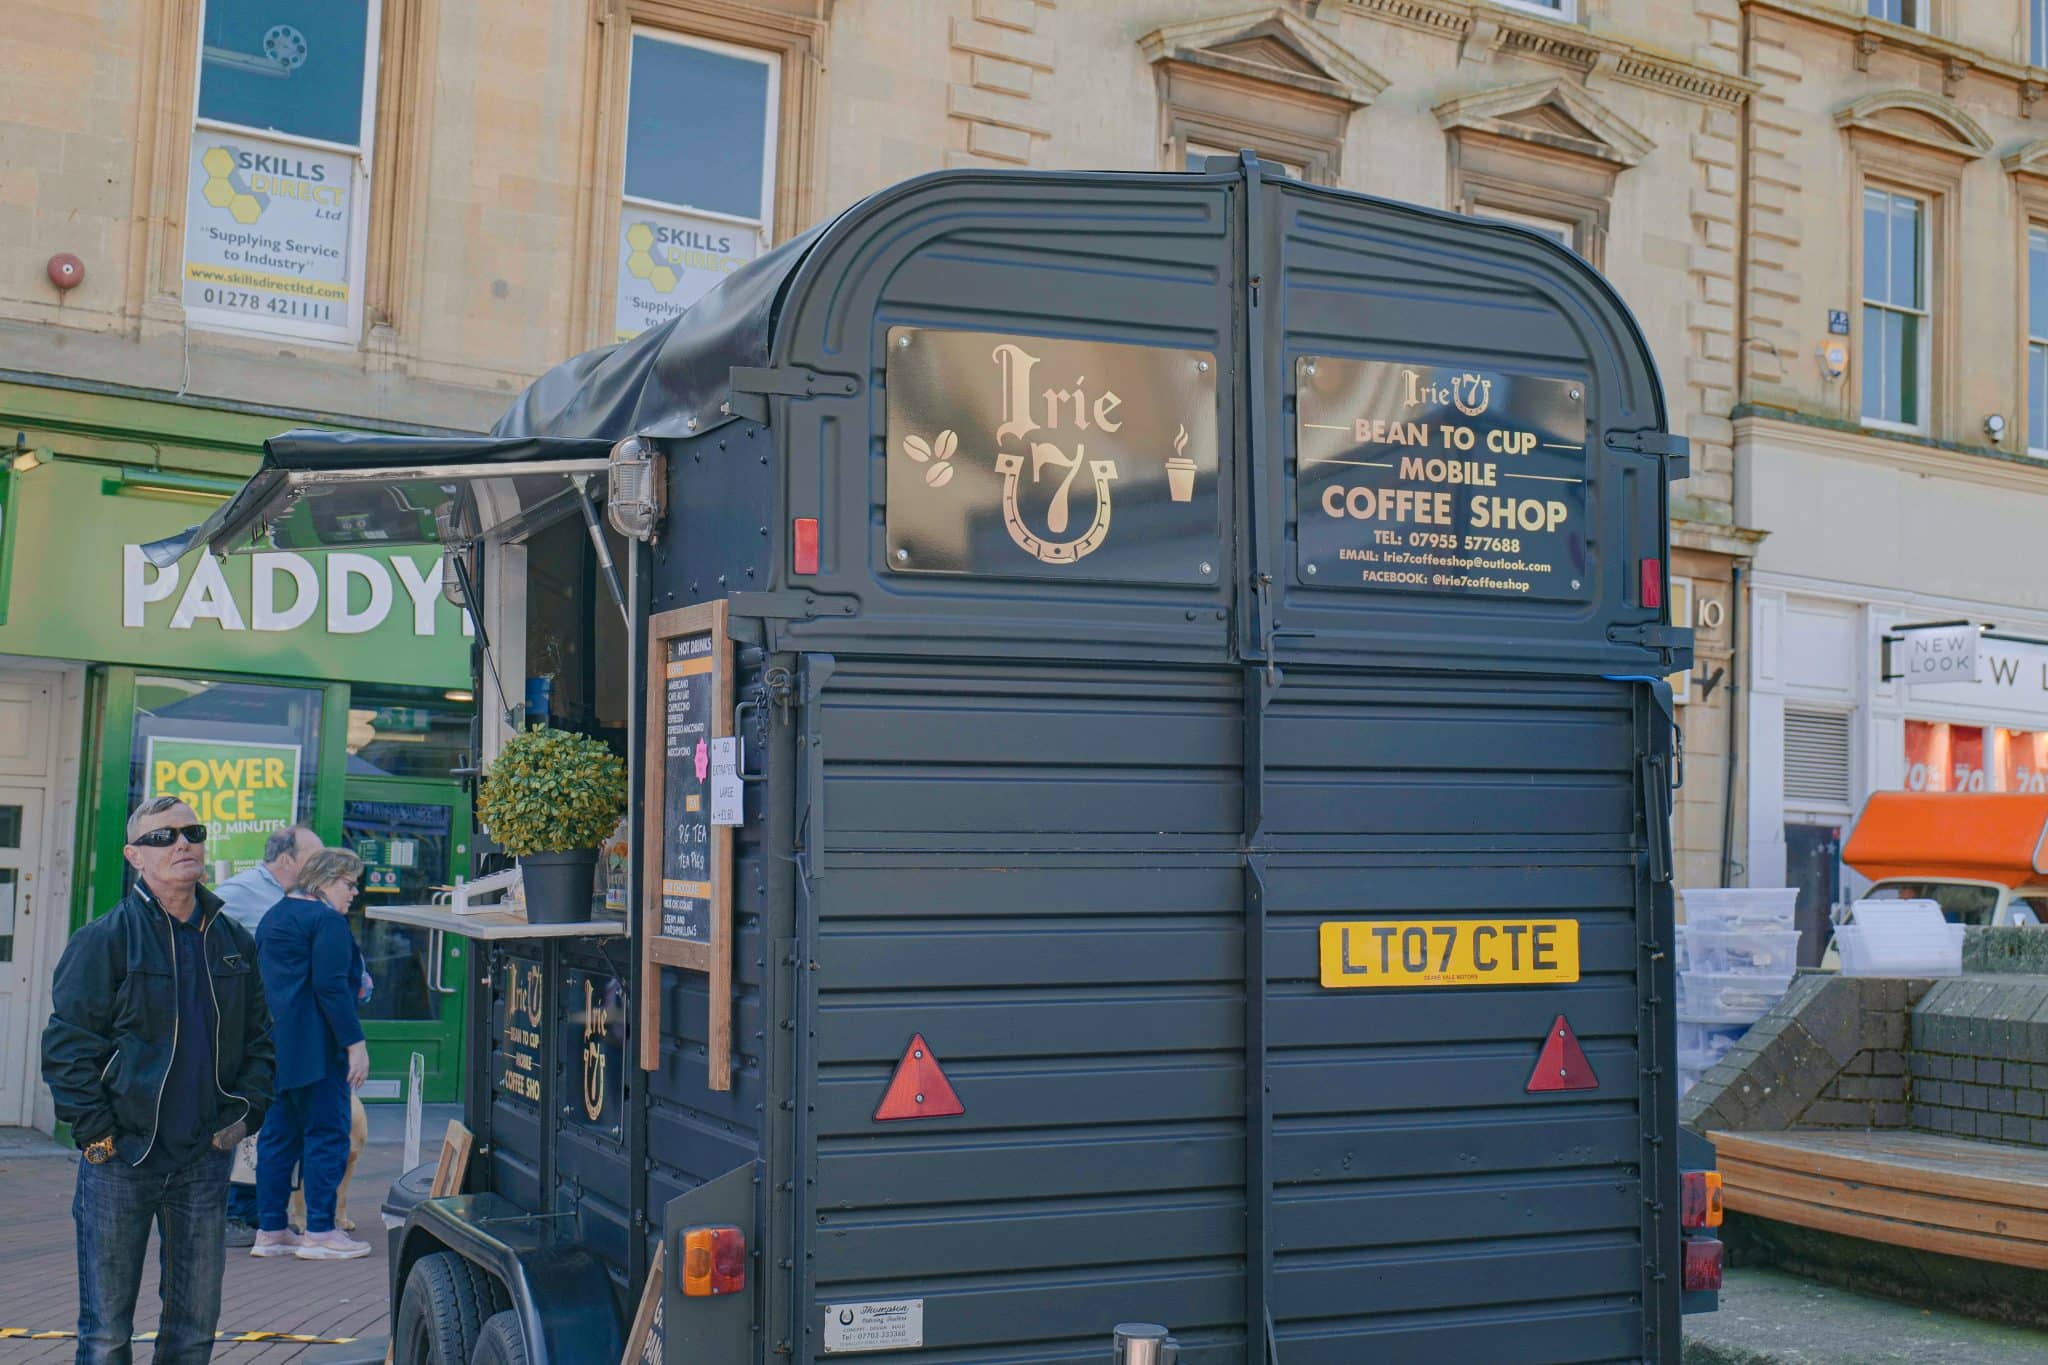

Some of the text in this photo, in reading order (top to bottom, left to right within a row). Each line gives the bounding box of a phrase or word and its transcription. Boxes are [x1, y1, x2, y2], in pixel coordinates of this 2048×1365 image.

[238, 151, 325, 181] SKILLS
[251, 174, 346, 206] DIRECT
[316, 208, 343, 221] Ltd
[285, 239, 339, 258] Service
[657, 226, 730, 253] SKILLS
[224, 249, 239, 260] to
[191, 268, 345, 299] www.skillsdirectltd.com
[204, 288, 329, 320] 01278 421111
[992, 343, 1122, 447] Irie
[1401, 369, 1449, 409] Irie
[1355, 419, 1537, 456] BEAN TO CUP
[1399, 457, 1497, 487] MOBILE
[1031, 442, 1085, 533] 7
[1321, 485, 1568, 532] COFFEE SHOP
[1374, 530, 1520, 553] TEL: 07955 577688
[1339, 549, 1379, 563] EMAIL:
[1362, 570, 1428, 585] FACEBOOK:
[678, 640, 690, 656] HOT
[690, 637, 712, 653] DRINKS
[1915, 637, 1965, 653] NEW
[1910, 655, 1970, 673] LOOK
[155, 757, 288, 791] POWER
[692, 824, 707, 843] TEA
[678, 855, 690, 869] TEA
[1341, 924, 1558, 975] LT07 CTE
[584, 979, 608, 1042] Irie
[529, 1033, 540, 1049] CUP
[505, 1069, 524, 1095] COFFEE
